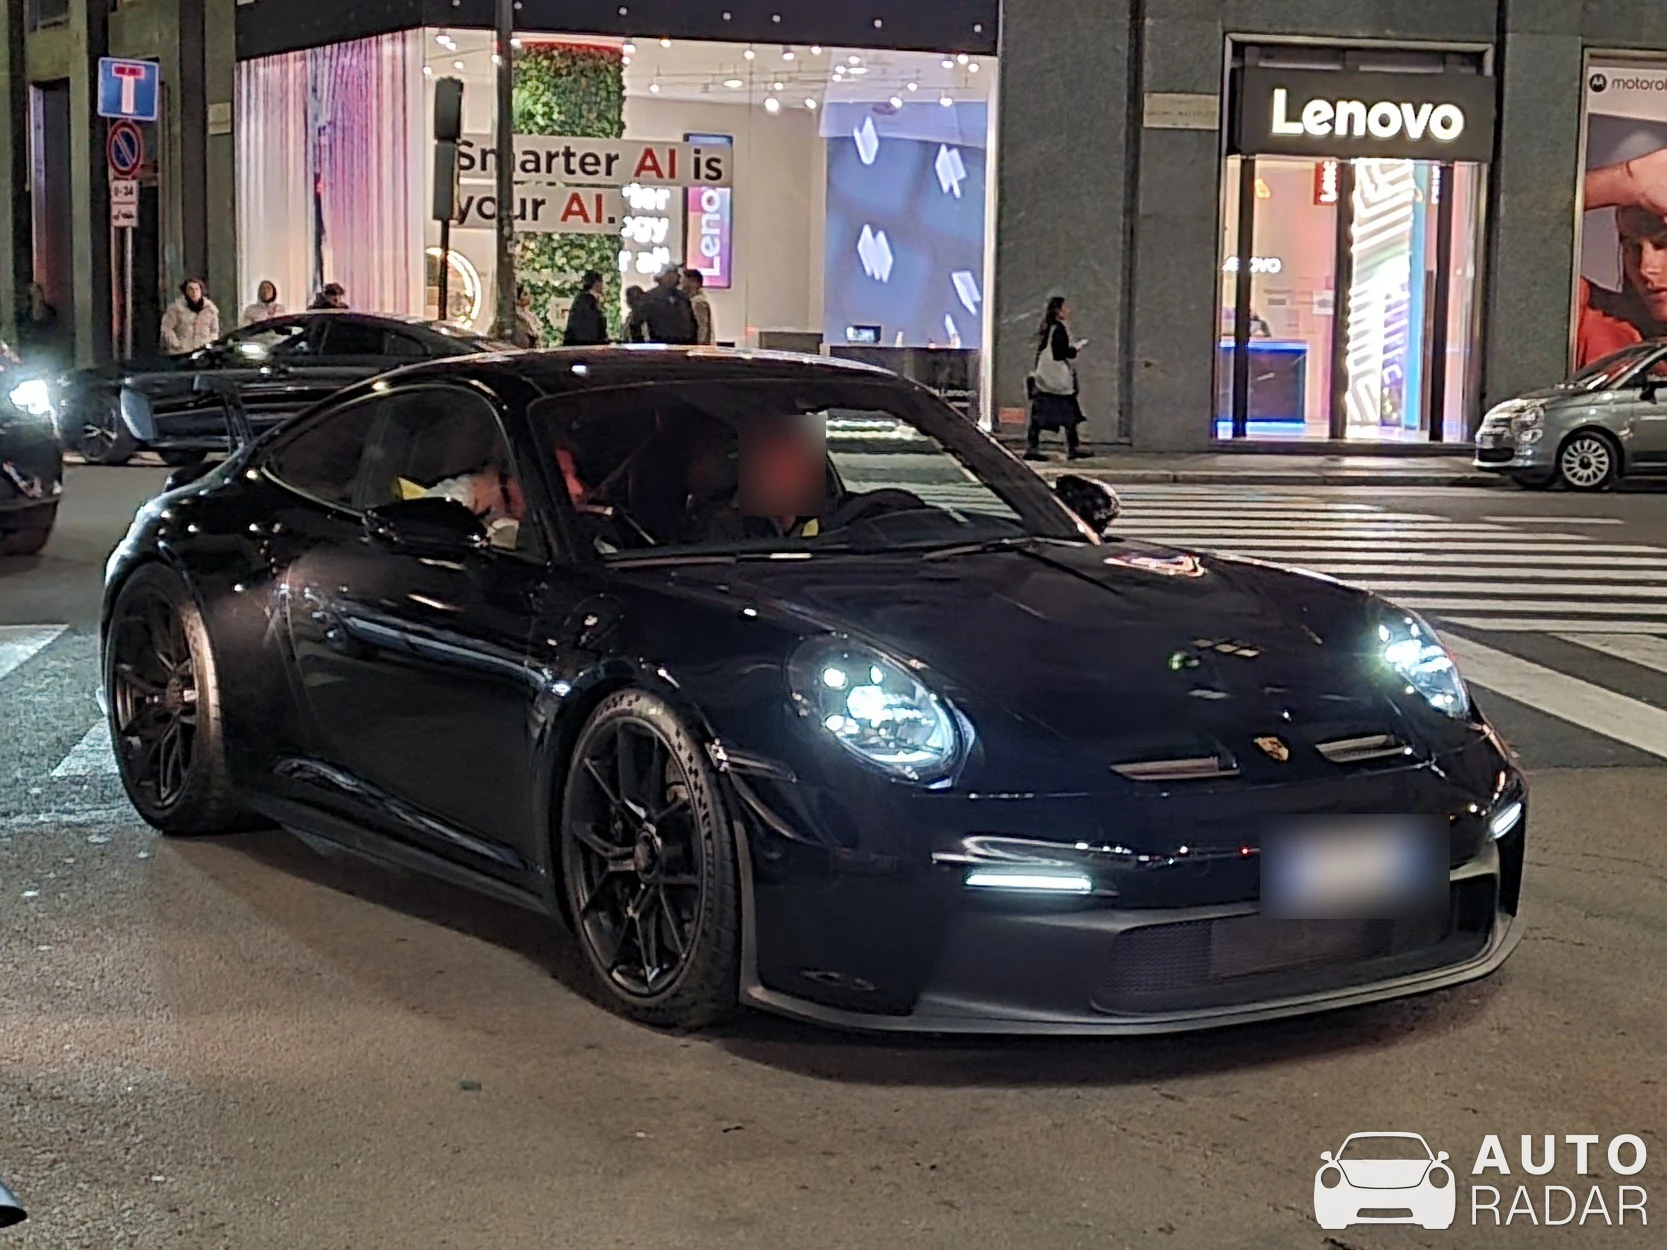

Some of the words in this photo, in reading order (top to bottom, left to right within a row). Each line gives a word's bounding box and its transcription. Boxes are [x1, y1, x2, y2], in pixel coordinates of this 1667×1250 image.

[1271, 88, 1465, 141] Lenovo
[633, 147, 676, 180] AI
[693, 148, 723, 182] is
[560, 192, 616, 225] AI.
